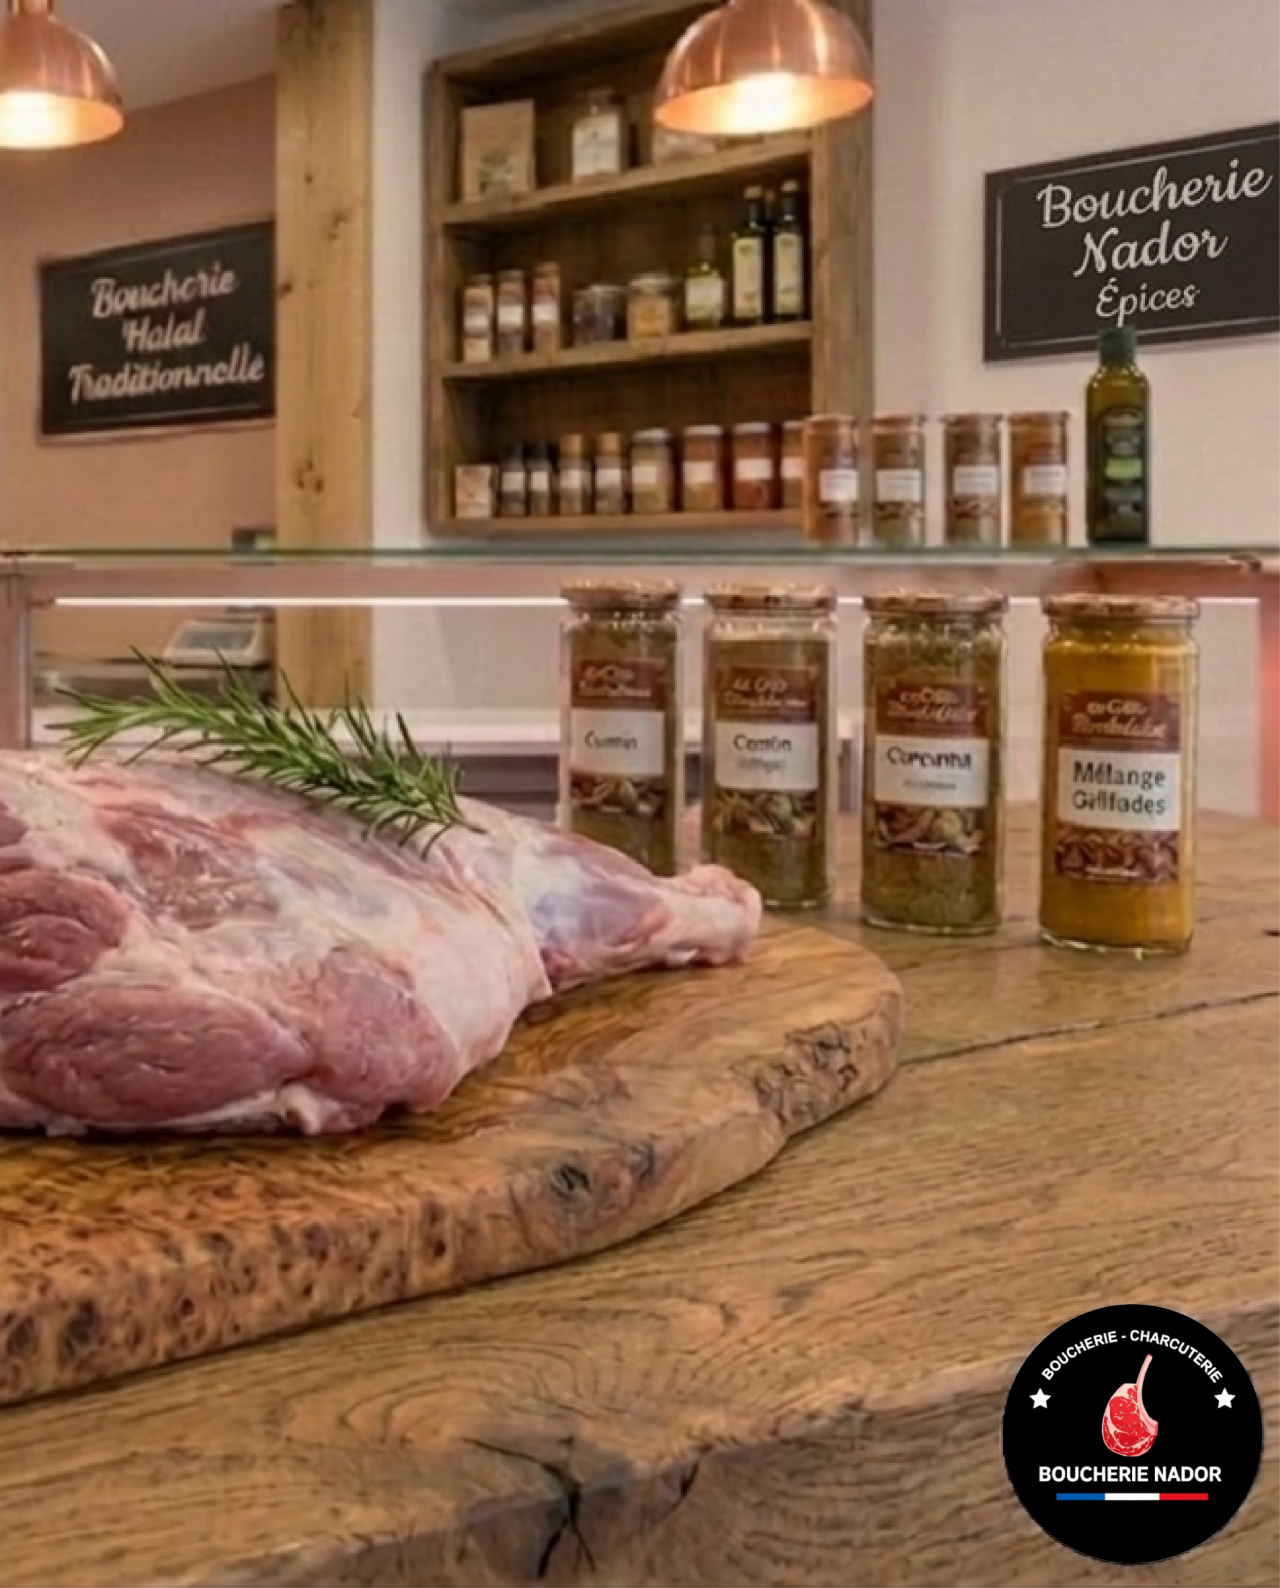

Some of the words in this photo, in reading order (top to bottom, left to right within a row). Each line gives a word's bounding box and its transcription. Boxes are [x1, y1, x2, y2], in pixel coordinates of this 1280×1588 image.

[1036, 158, 1273, 228] Boucherie
[1073, 219, 1229, 277] Nador
[1095, 277, 1200, 328] Épices
